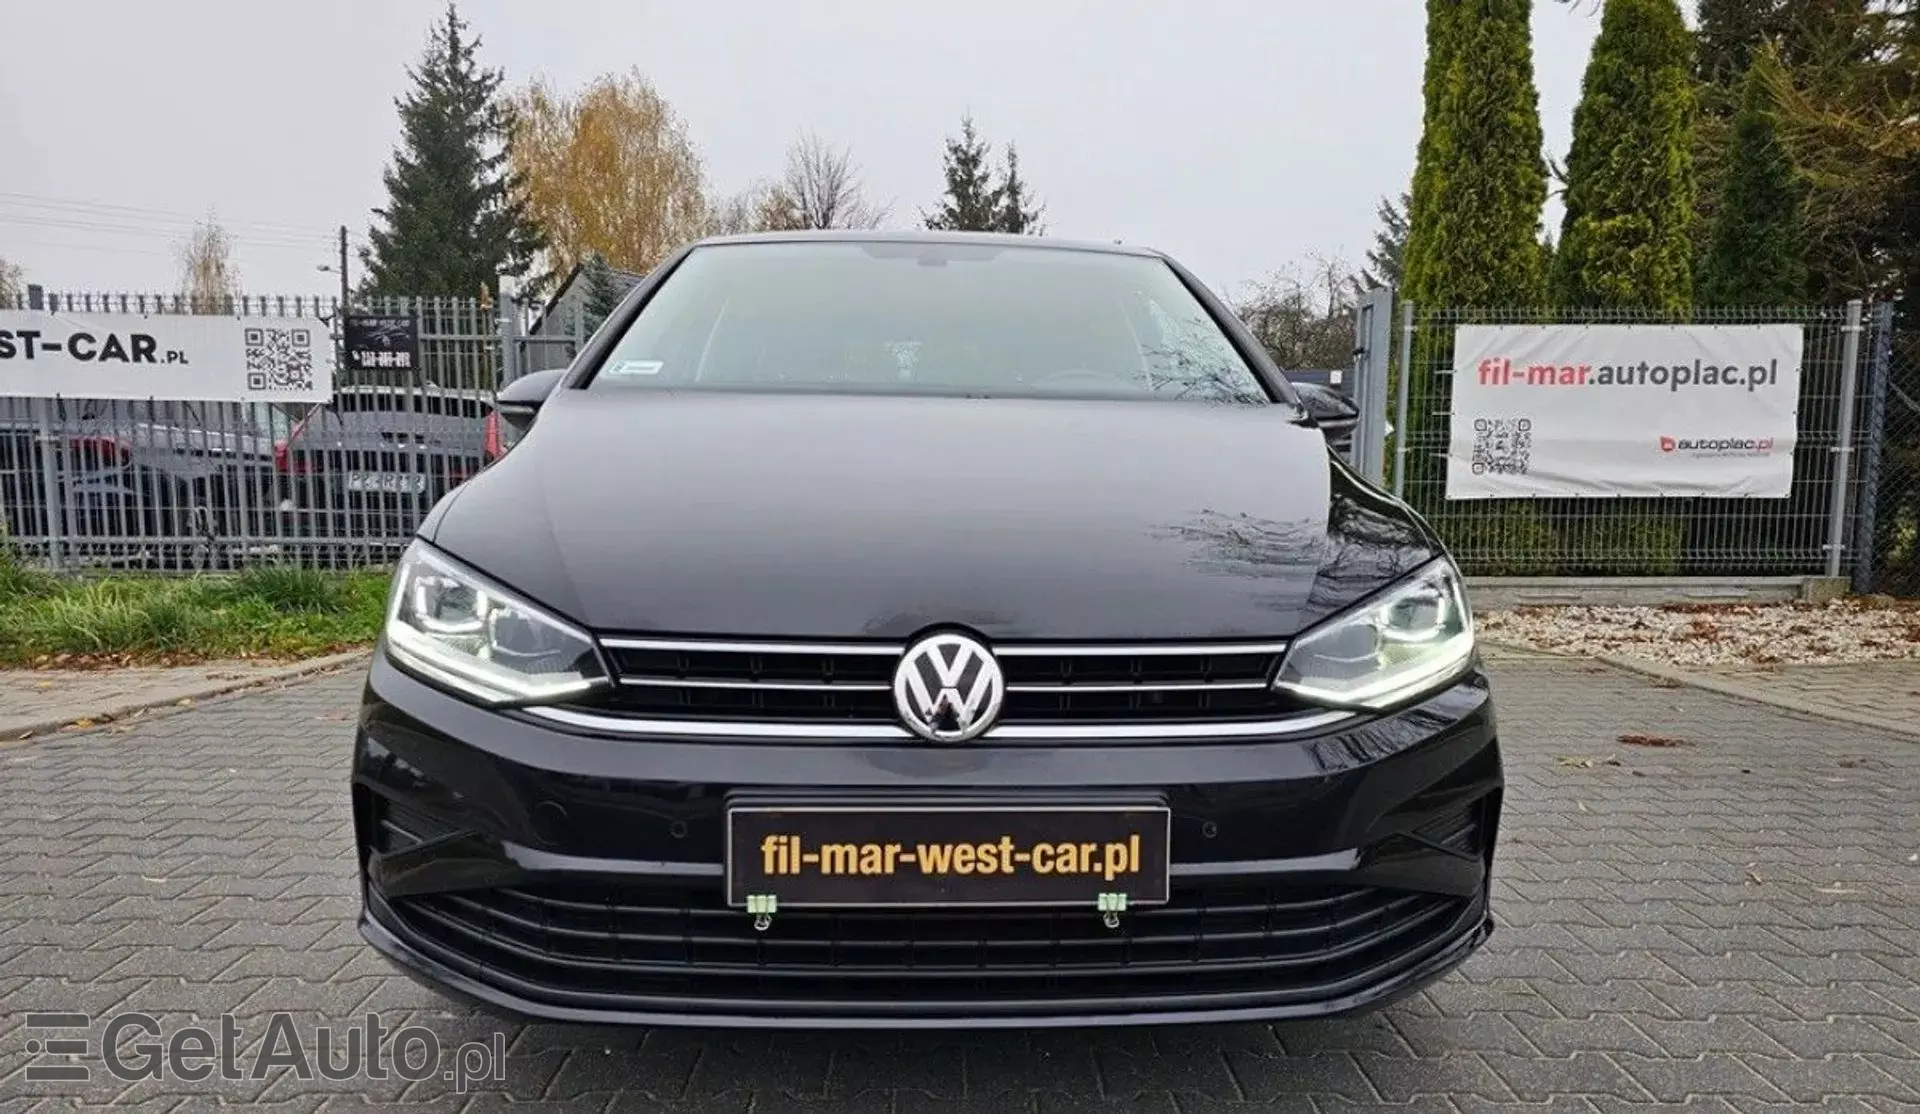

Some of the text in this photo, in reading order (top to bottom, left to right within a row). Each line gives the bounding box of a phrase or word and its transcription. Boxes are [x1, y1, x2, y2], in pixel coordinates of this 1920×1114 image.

[1478, 358, 1777, 392] fil-mar.autoplac.pl
[1678, 437, 1774, 451] autoplac.pl
[762, 835, 1140, 881] fil-mar-west-car.pl
